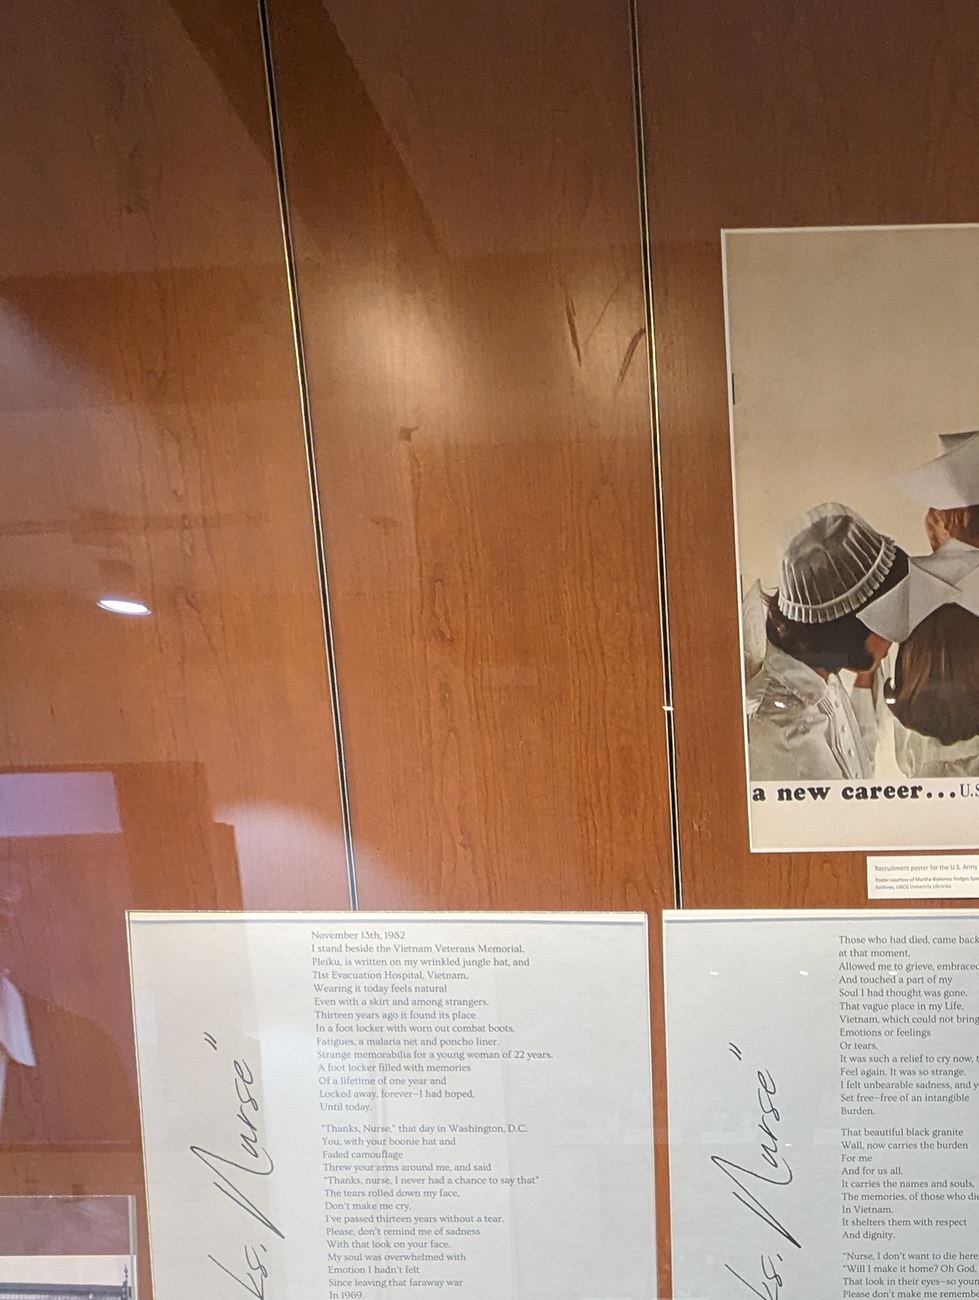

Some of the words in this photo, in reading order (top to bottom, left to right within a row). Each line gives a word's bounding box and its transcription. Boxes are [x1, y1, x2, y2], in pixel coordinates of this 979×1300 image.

[752, 787, 766, 802] a
[777, 786, 831, 802] new
[311, 930, 359, 940] November
[384, 930, 406, 940] 1982
[838, 935, 866, 945] Those
[867, 935, 888, 944] who
[890, 935, 907, 945] had
[932, 937, 957, 945] came
[958, 935, 979, 945] back
[311, 944, 315, 953] I
[317, 943, 343, 953] stand
[344, 943, 374, 953] beside
[376, 943, 392, 953] the
[393, 944, 433, 953] Vietnam
[434, 943, 476, 953] Veterans
[838, 950, 848, 958] at
[849, 948, 868, 958] that
[881, 1014, 910, 1024] which
[911, 1014, 937, 1024] could
[939, 1016, 954, 1024] not
[956, 1014, 979, 1026] bring
[841, 1127, 861, 1137] That
[864, 1127, 904, 1137] beautiful
[906, 1127, 930, 1137] black
[932, 1128, 964, 1139] granite
[866, 1142, 886, 1150] now
[887, 1141, 918, 1150] carries
[919, 1140, 935, 1150] the
[936, 1140, 969, 1150] burden
